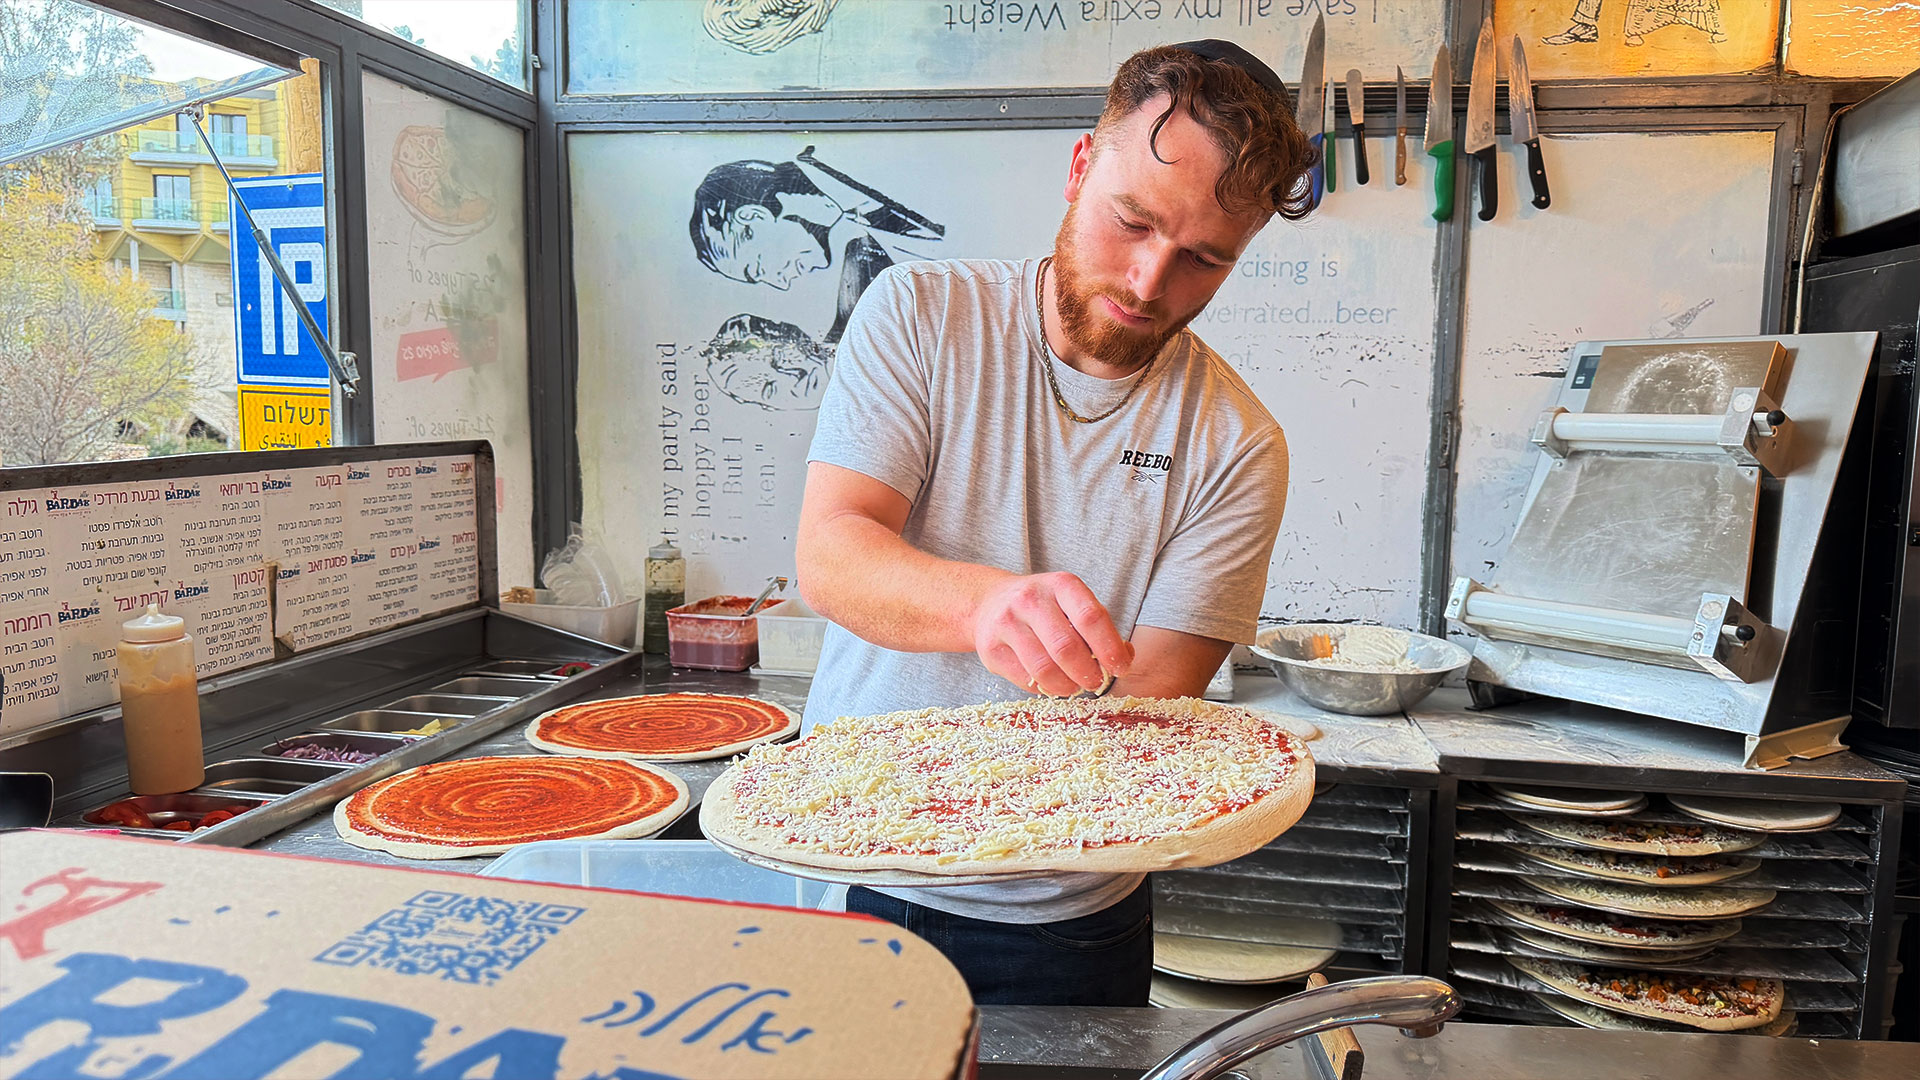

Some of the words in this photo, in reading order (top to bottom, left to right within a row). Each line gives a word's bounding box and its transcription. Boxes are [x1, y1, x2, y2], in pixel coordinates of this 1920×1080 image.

[944, 0, 1066, 32] Weight
[1321, 254, 1338, 277] is
[656, 342, 678, 395] said
[690, 375, 711, 433] beer
[658, 405, 683, 472] party
[691, 442, 716, 518] hoppy
[722, 454, 743, 495] But
[246, 481, 259, 493] בר
[315, 474, 342, 489] בקעה
[132, 489, 160, 502] גבעת
[220, 483, 243, 496] יוחאי
[94, 491, 128, 505] מרדכי
[662, 482, 683, 517] my
[8, 497, 39, 516] גילה
[89, 523, 110, 533] פסטו
[113, 519, 140, 530] אלפרדו
[184, 521, 207, 532] גבינות
[247, 529, 261, 538] לפני
[108, 536, 138, 547] תערובת
[150, 549, 165, 559] לפני
[28, 566, 47, 578] לפני
[148, 565, 166, 577] קונפי
[308, 560, 322, 573] זאב
[105, 572, 128, 583] וגבינת
[131, 569, 145, 578] שום
[233, 569, 265, 589] קטמון
[83, 576, 103, 586] עיזים
[27, 586, 49, 598] אחרי
[114, 596, 137, 612] יובל
[5, 613, 52, 635] רוממה
[5, 642, 28, 655] הבית
[92, 648, 117, 661] גבינות
[40, 672, 58, 685] לפני
[85, 670, 109, 684] קישוא
[28, 685, 60, 701] עגבניות
[6, 696, 24, 707] וזיתי
